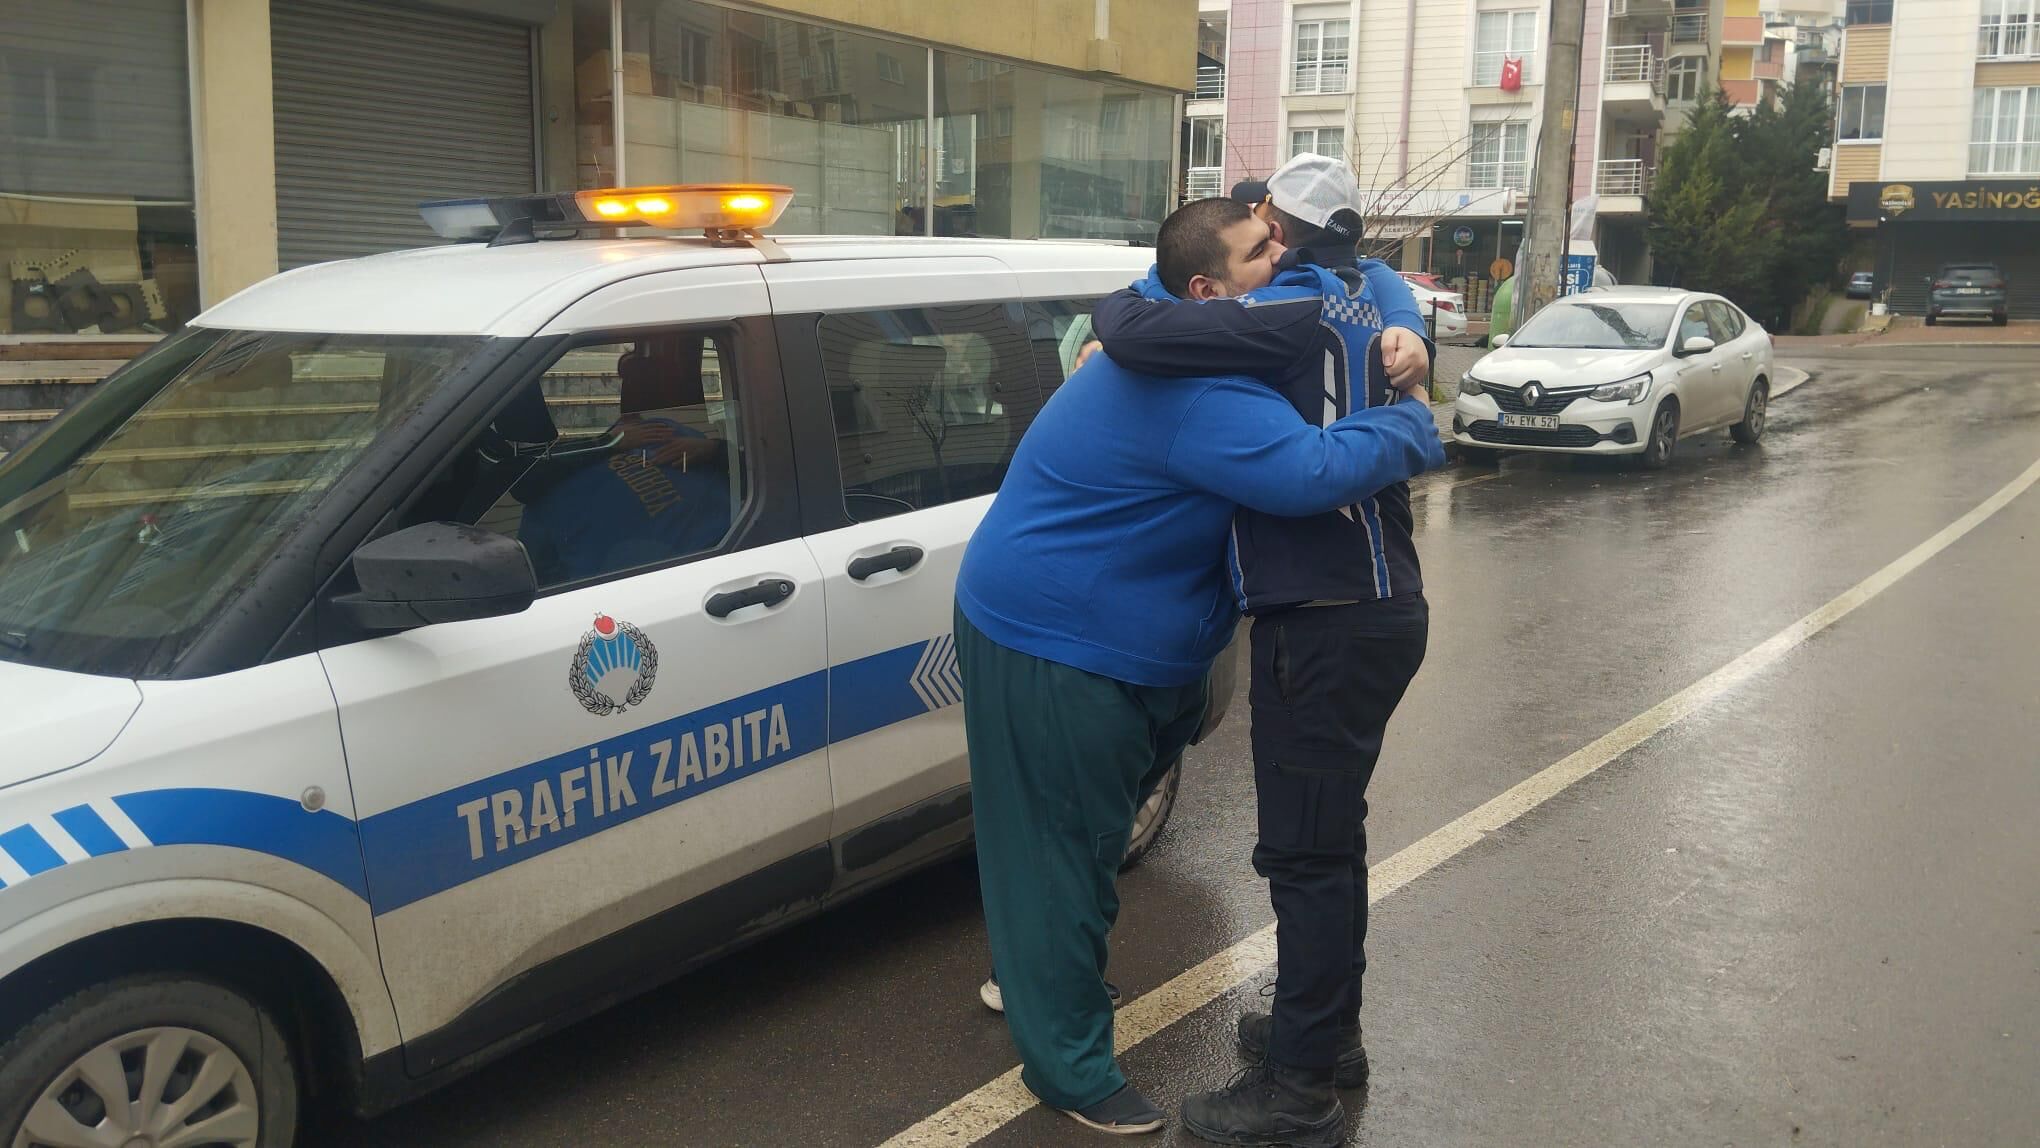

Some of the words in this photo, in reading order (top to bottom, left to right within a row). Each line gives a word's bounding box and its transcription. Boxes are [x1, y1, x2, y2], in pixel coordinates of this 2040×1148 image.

[1504, 415, 1515, 425] 34
[1520, 414, 1537, 426] EYK
[1541, 416, 1557, 428] 521
[457, 746, 638, 861] TRAFİK
[650, 703, 791, 799] ZABITA
